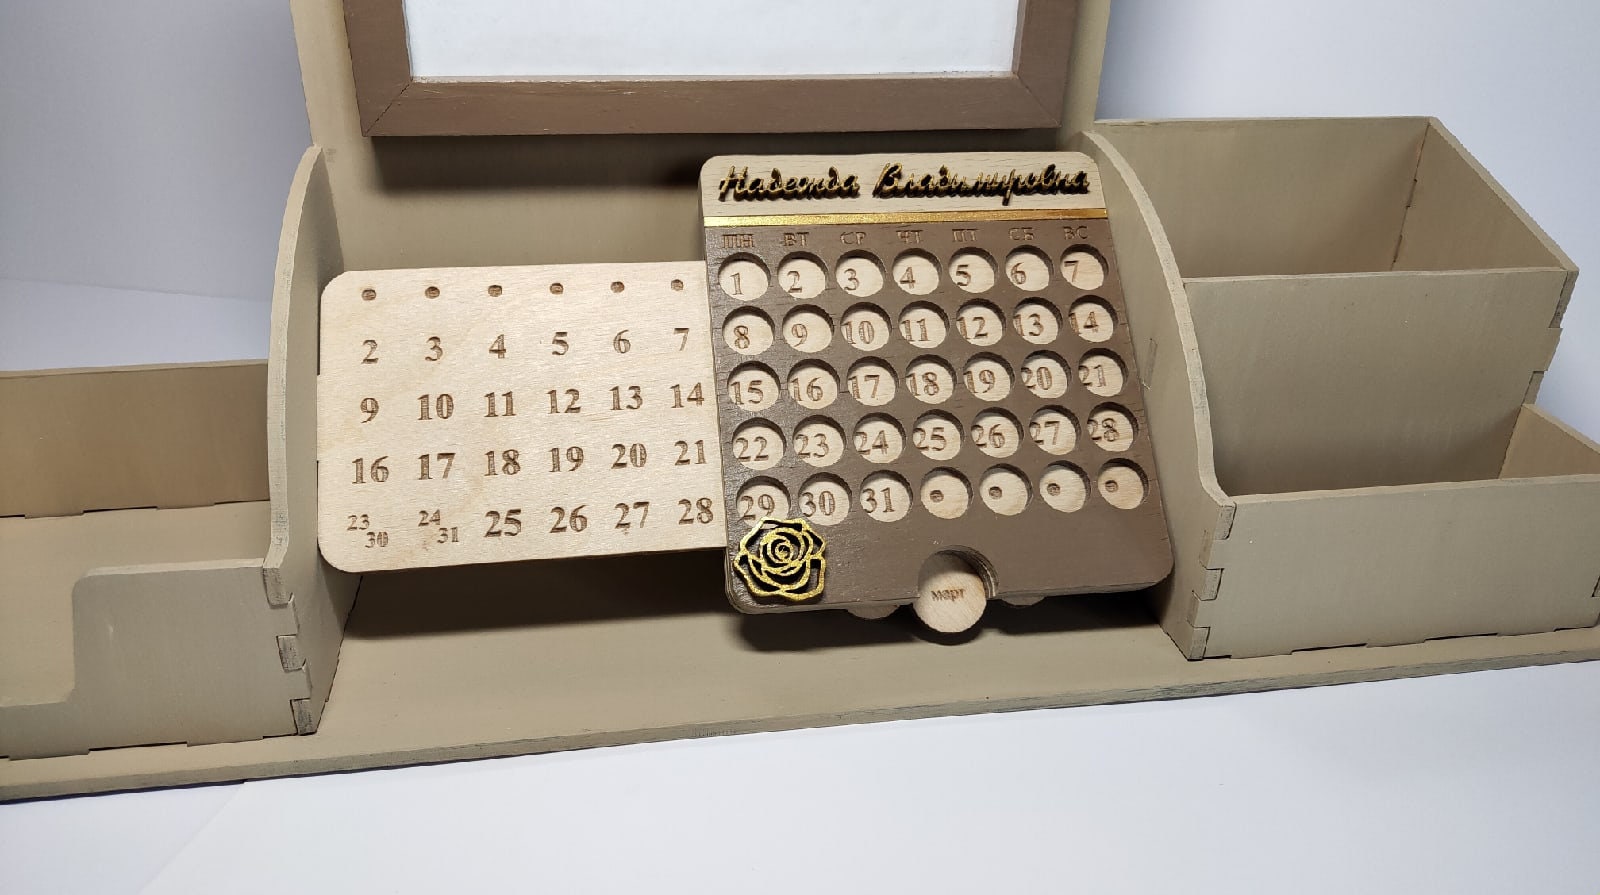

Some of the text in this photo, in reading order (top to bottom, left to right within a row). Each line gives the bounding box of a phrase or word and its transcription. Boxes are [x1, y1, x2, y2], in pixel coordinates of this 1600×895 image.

[718, 165, 860, 201] Надежда
[722, 226, 1088, 249] ПН ВТ СР ЧТ ПТ СБ ВС
[730, 260, 1079, 295] 1 2 3 4 5 6 7
[361, 327, 689, 364] 2 3 4 5 6 7
[734, 311, 1099, 349] 8 9 10 11 12 13 14
[360, 382, 704, 423] 9 10 11 12 13 14
[731, 364, 1107, 405] 15 16 17 18 19 20 21
[735, 417, 1119, 462] 22 23 24 25 26 27 28
[352, 440, 707, 484] 16 17 18 19 20 21
[347, 497, 714, 538] 23 24 25 26 27 28
[739, 487, 895, 520] 29 30 31
[365, 526, 459, 548] 30 31
[930, 588, 966, 602] март
